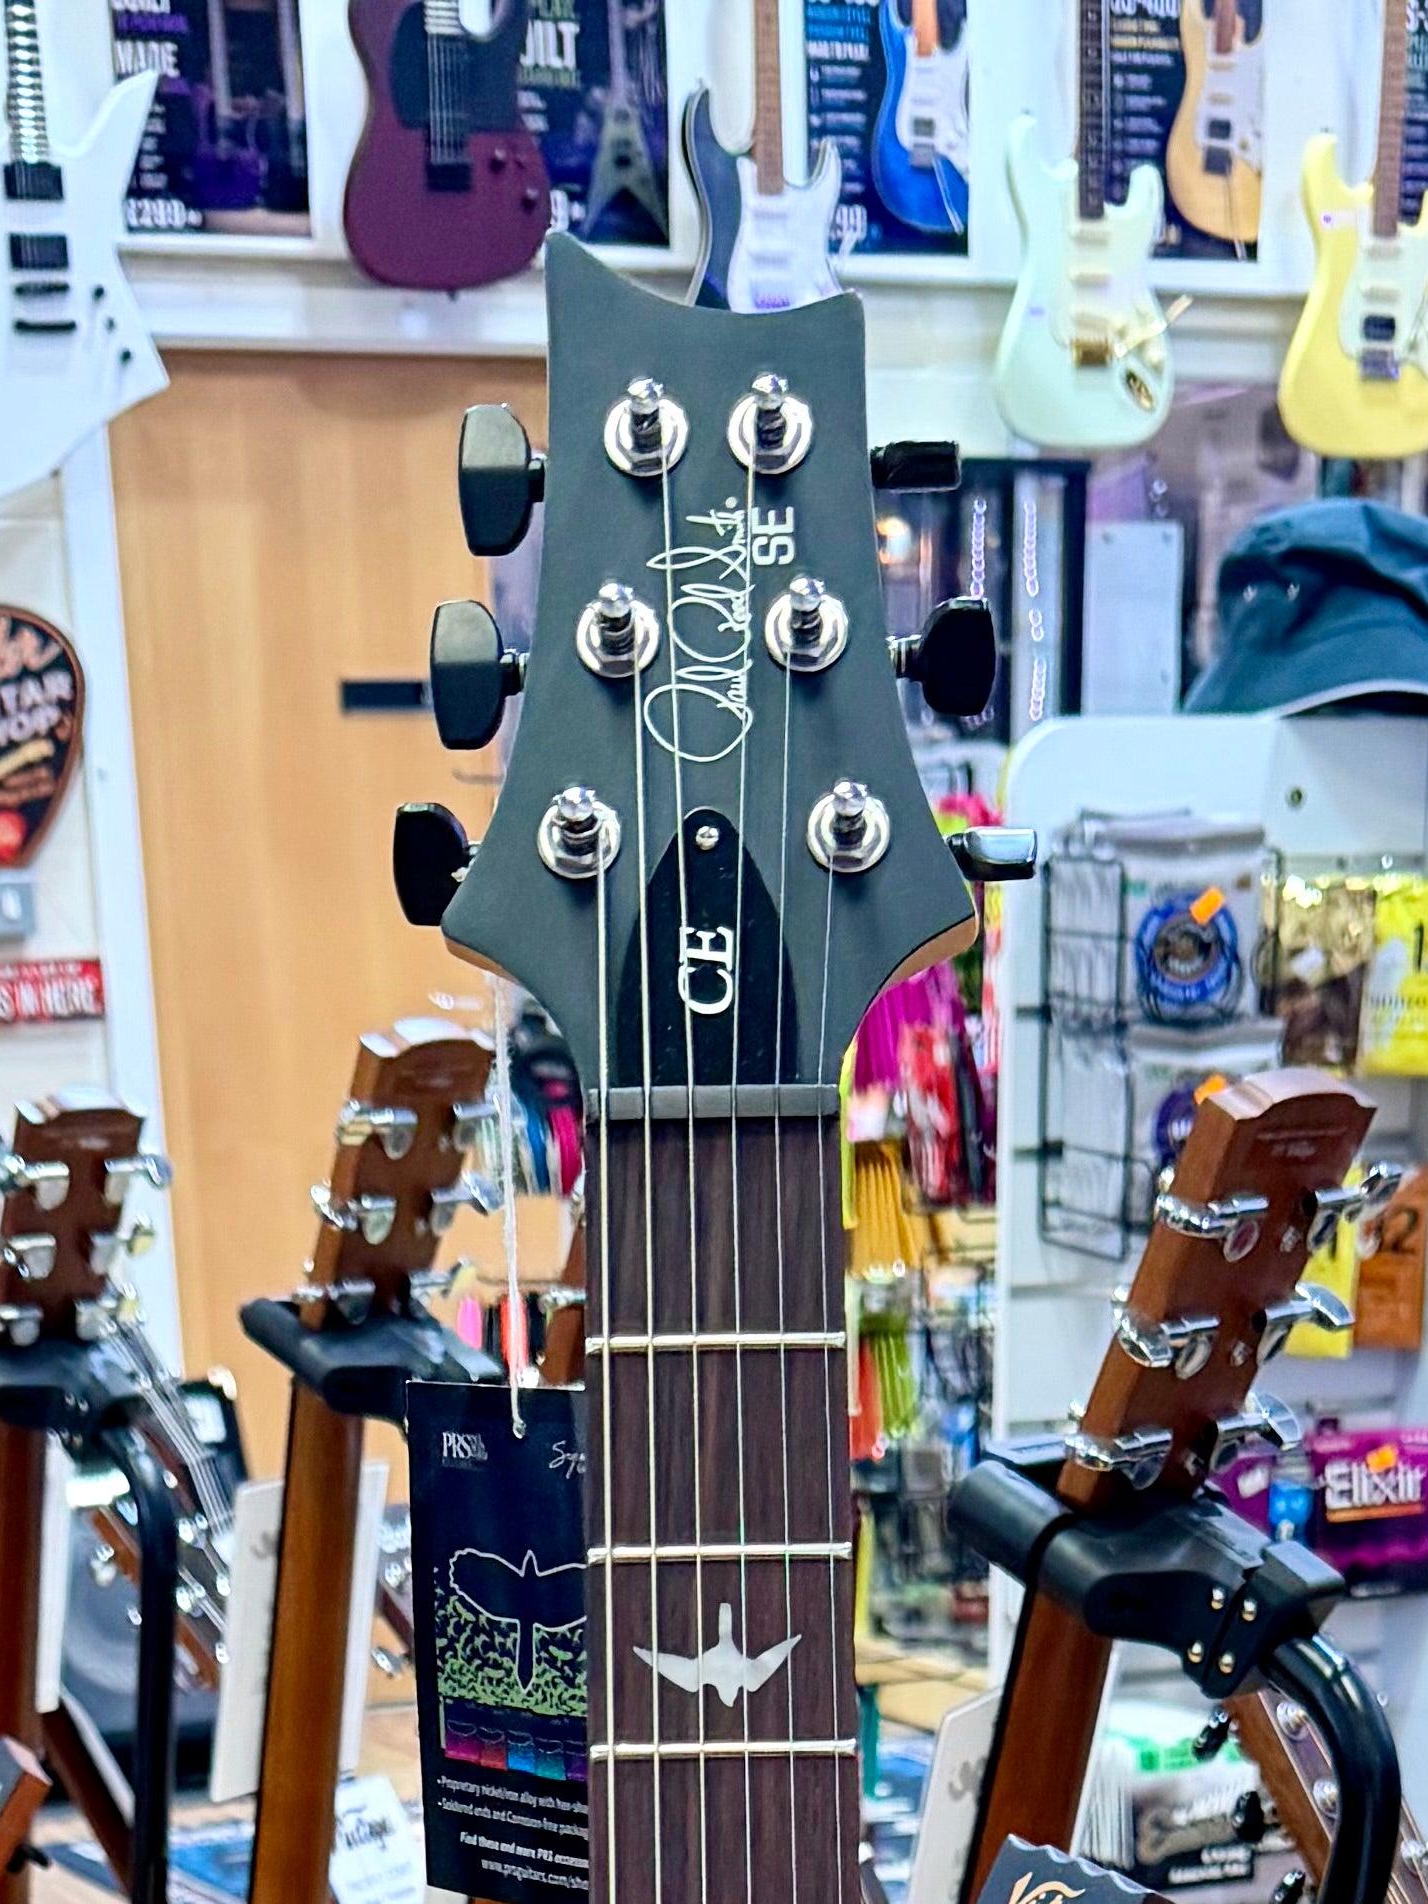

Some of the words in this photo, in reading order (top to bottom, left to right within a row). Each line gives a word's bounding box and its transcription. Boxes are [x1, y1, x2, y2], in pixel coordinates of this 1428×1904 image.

[751, 505, 795, 566] SE
[677, 924, 733, 1015] CE
[1325, 1459, 1427, 1510] Elixir
